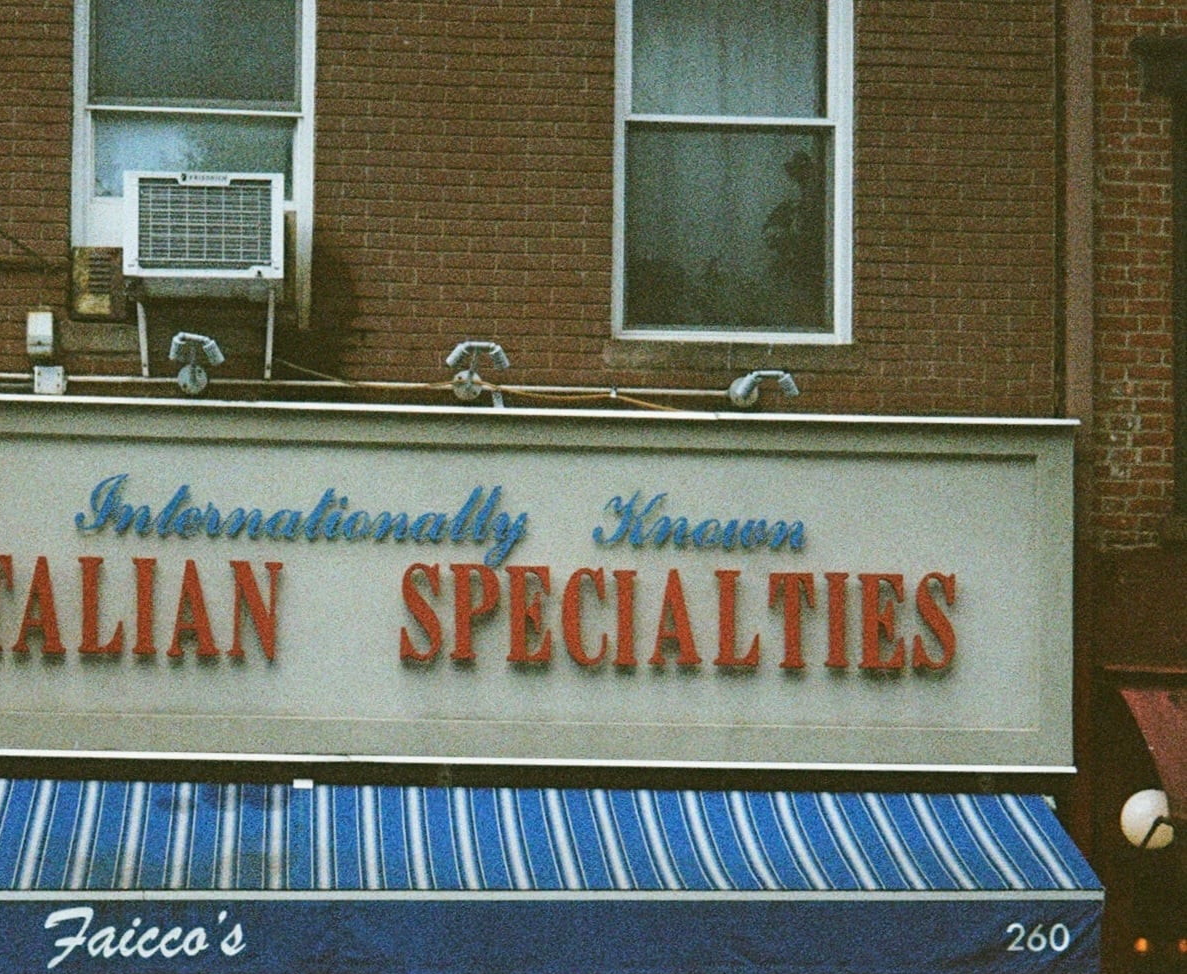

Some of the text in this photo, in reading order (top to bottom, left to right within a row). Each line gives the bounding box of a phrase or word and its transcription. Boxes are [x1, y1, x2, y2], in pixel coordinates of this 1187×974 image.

[74, 472, 807, 567] Internationally Known
[400, 563, 956, 669] SPECIALTIES
[44, 906, 246, 969] Faicco's
[1006, 923, 1070, 952] 260
